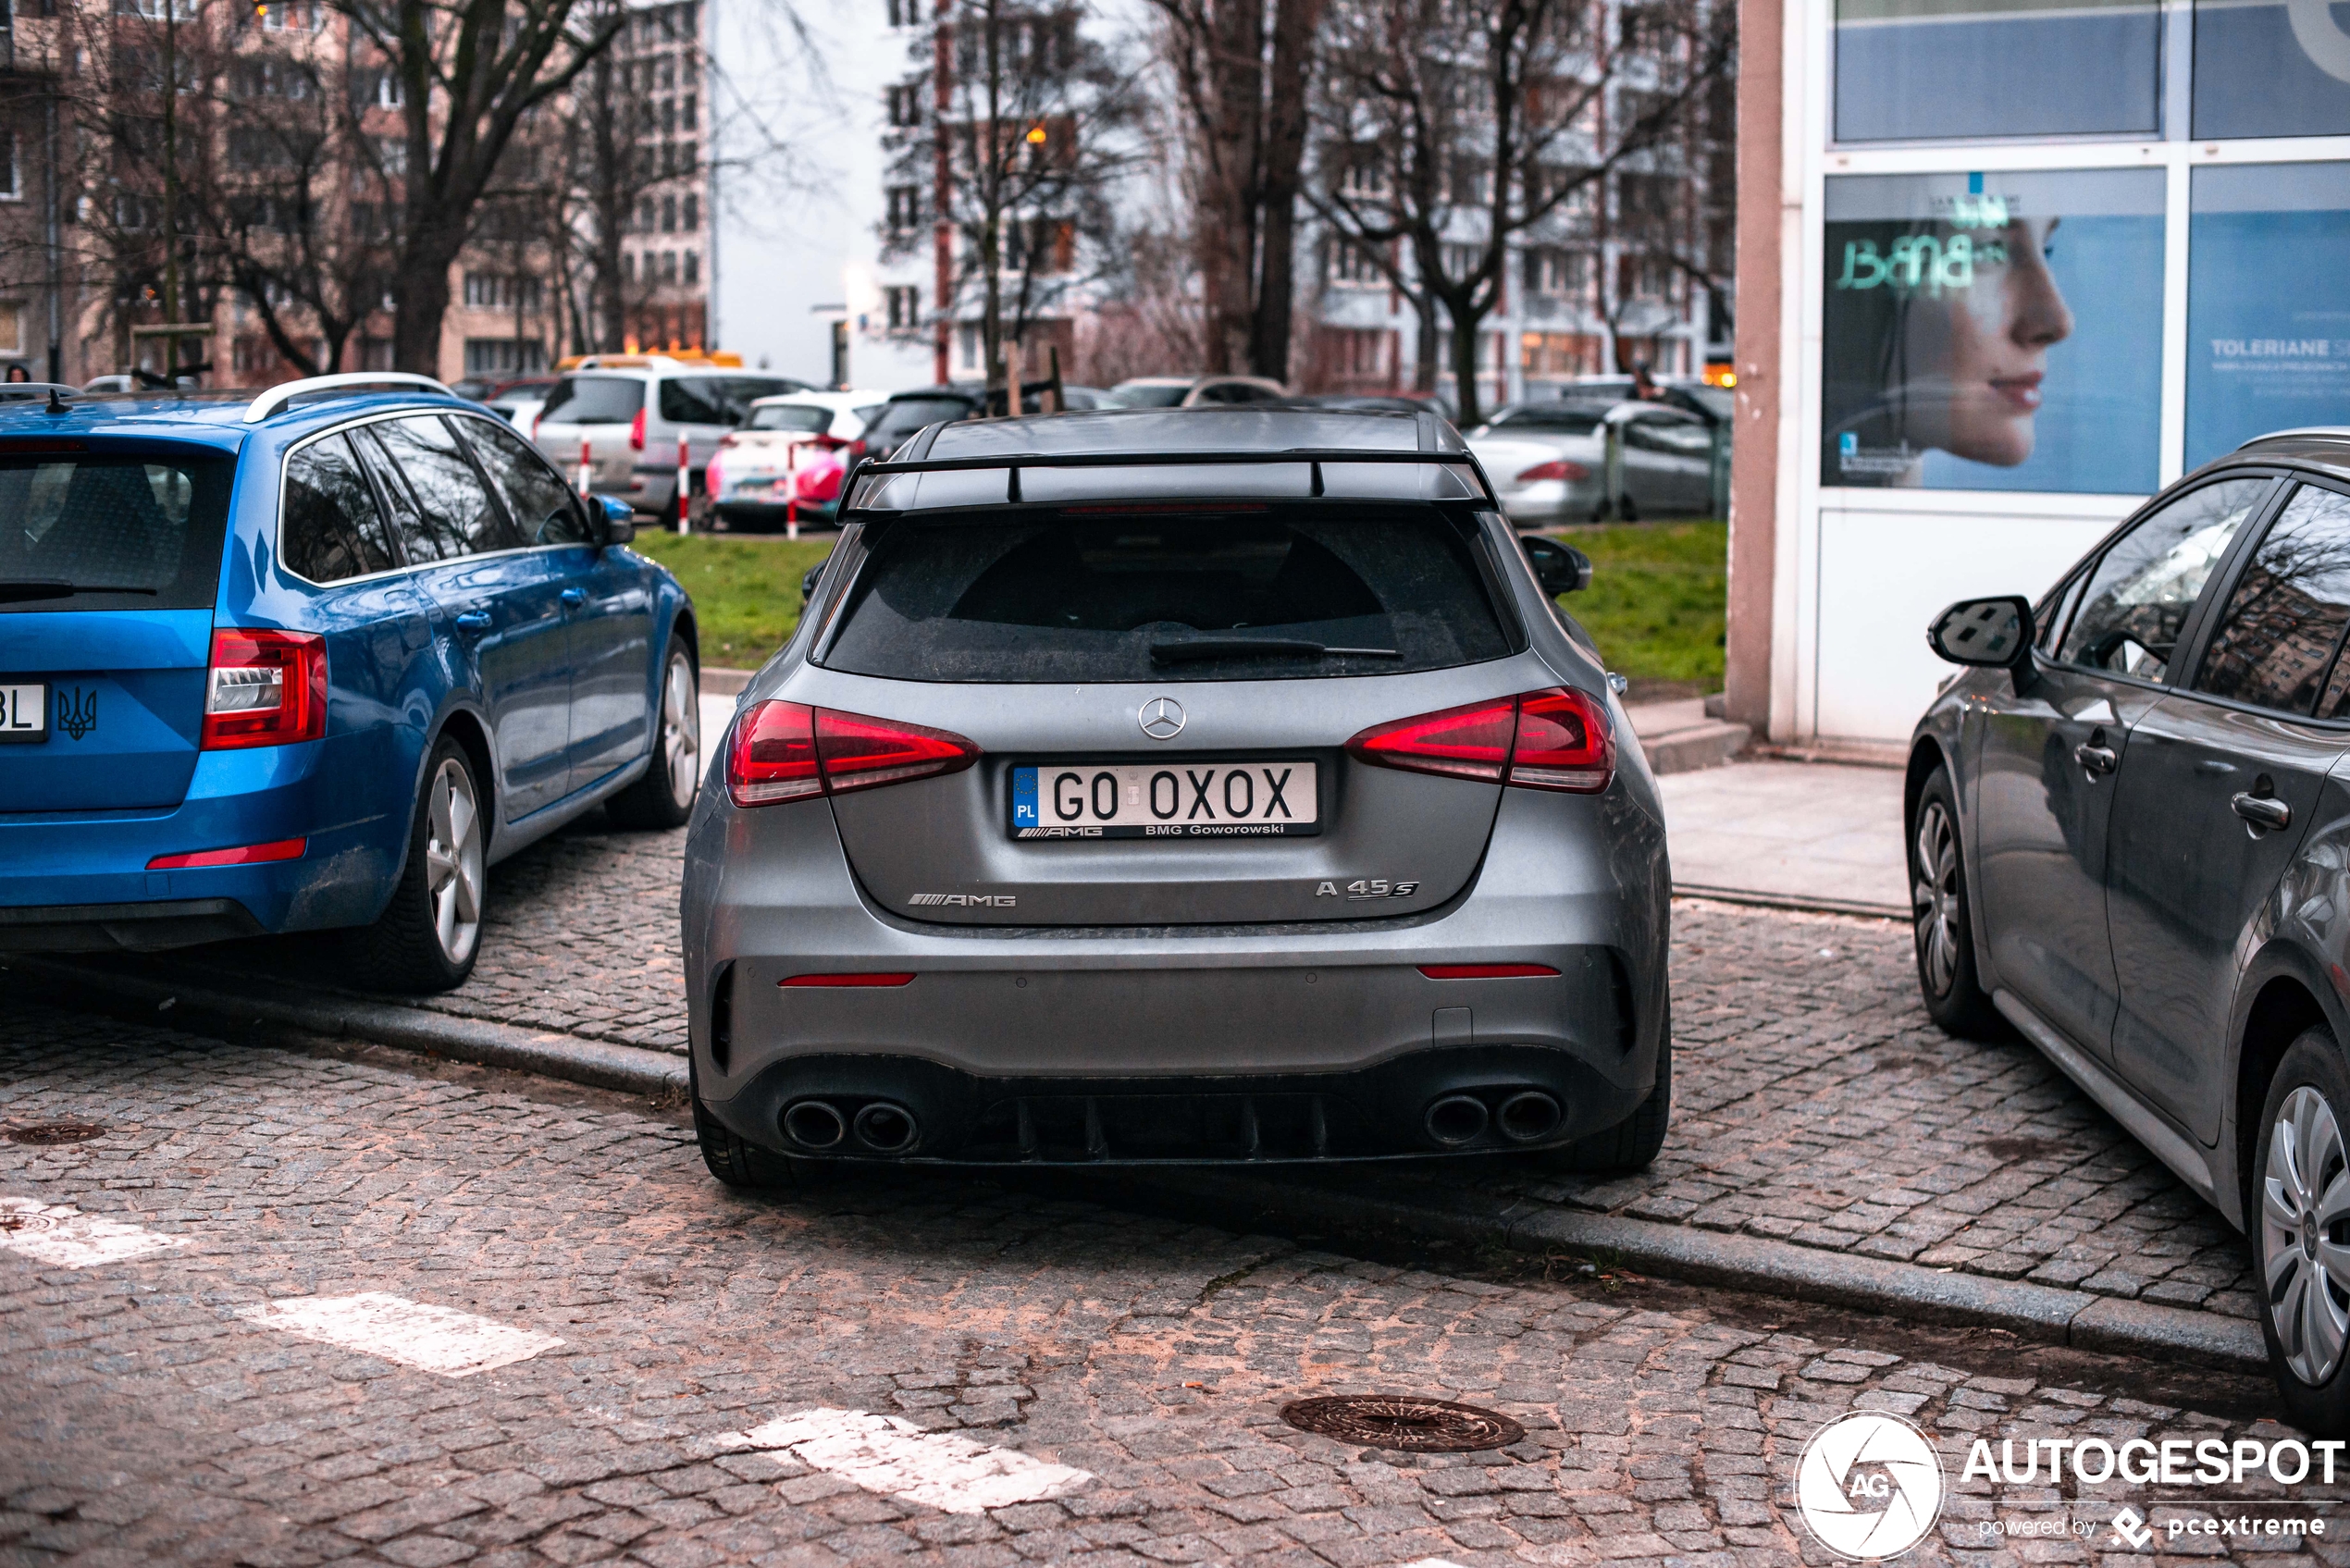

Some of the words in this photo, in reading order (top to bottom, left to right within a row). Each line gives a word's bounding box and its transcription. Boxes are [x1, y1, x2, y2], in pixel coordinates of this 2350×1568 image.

[2210, 339, 2329, 356] TOLERIANE
[1018, 805, 1035, 818] PL
[1044, 826, 1103, 837] AMG
[1145, 825, 1182, 835] BMG
[1189, 823, 1284, 834] Goworowski
[1316, 882, 1338, 896] A
[942, 894, 1016, 907] AMG
